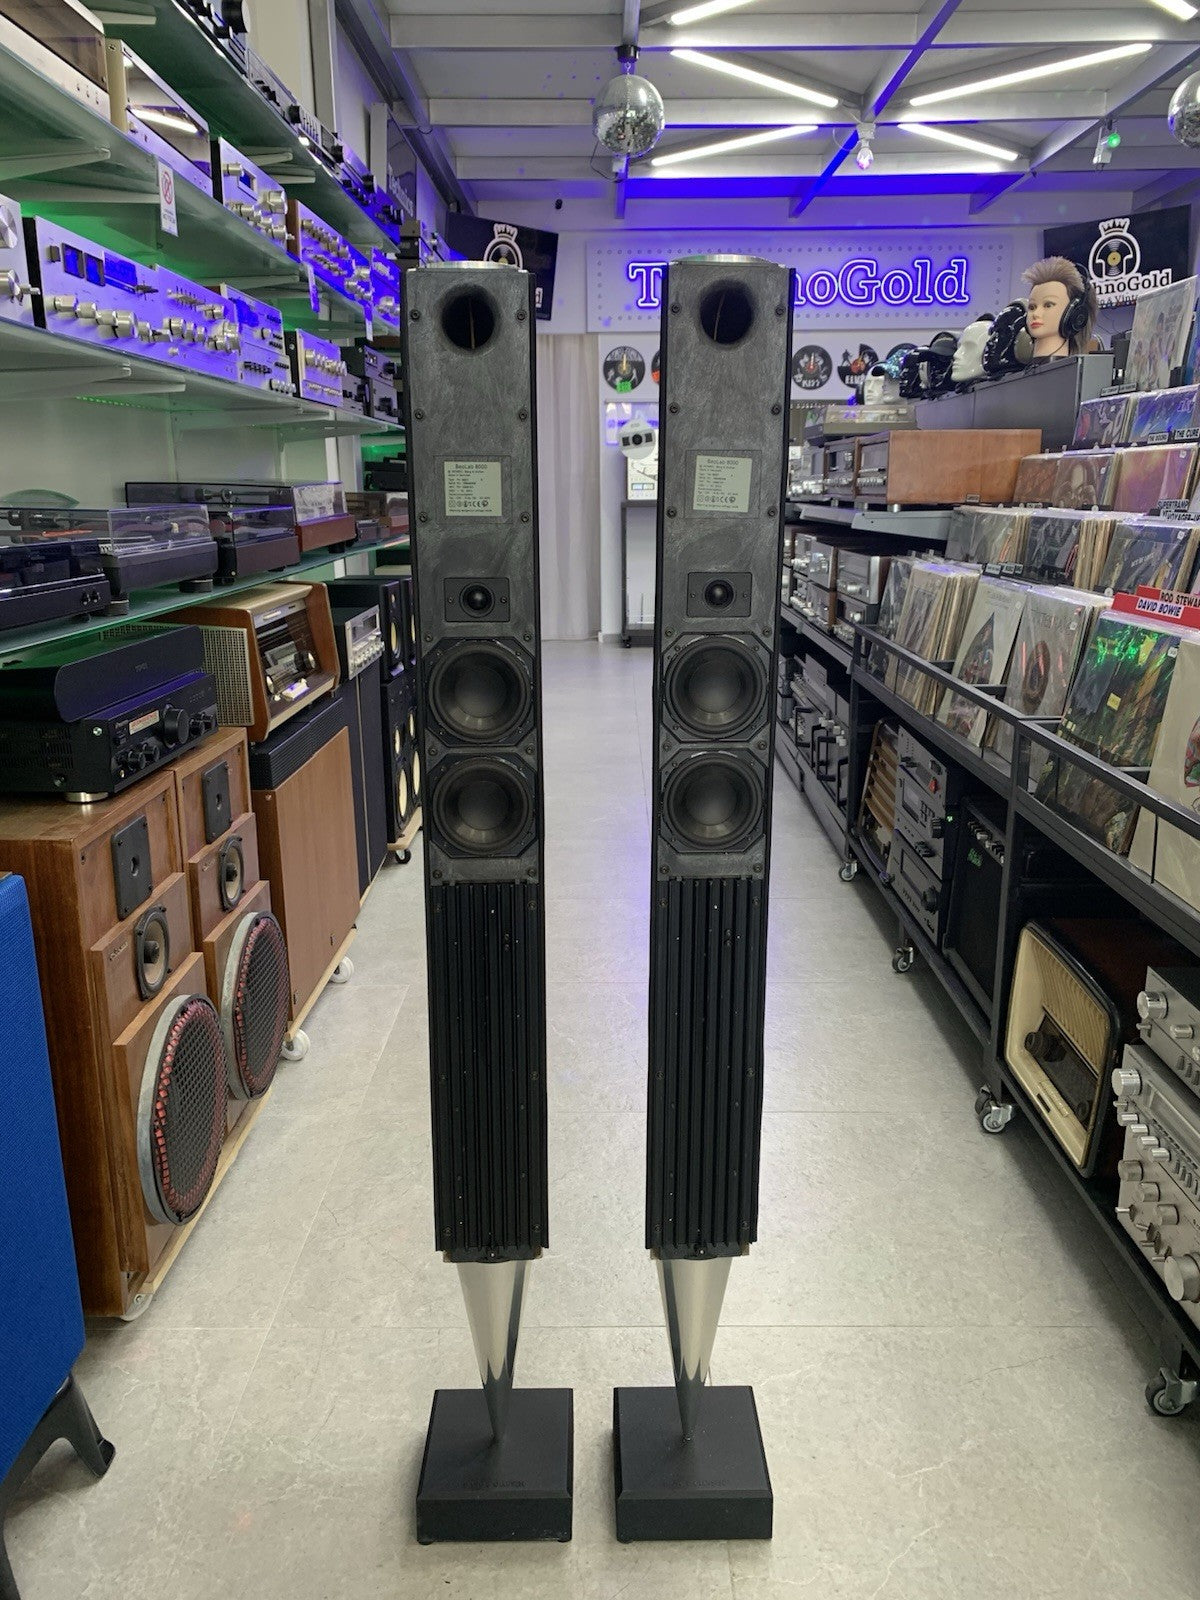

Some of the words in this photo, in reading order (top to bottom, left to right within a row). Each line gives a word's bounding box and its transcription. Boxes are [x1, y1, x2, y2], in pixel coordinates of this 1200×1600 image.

[1186, 428, 1199, 438] CURE
[1158, 500, 1189, 510] SUPERTRAMP
[1161, 592, 1173, 603] ROD
[1176, 594, 1200, 608] STEWAR
[1138, 599, 1158, 612] DAVID
[1158, 603, 1182, 617] BOWIE
